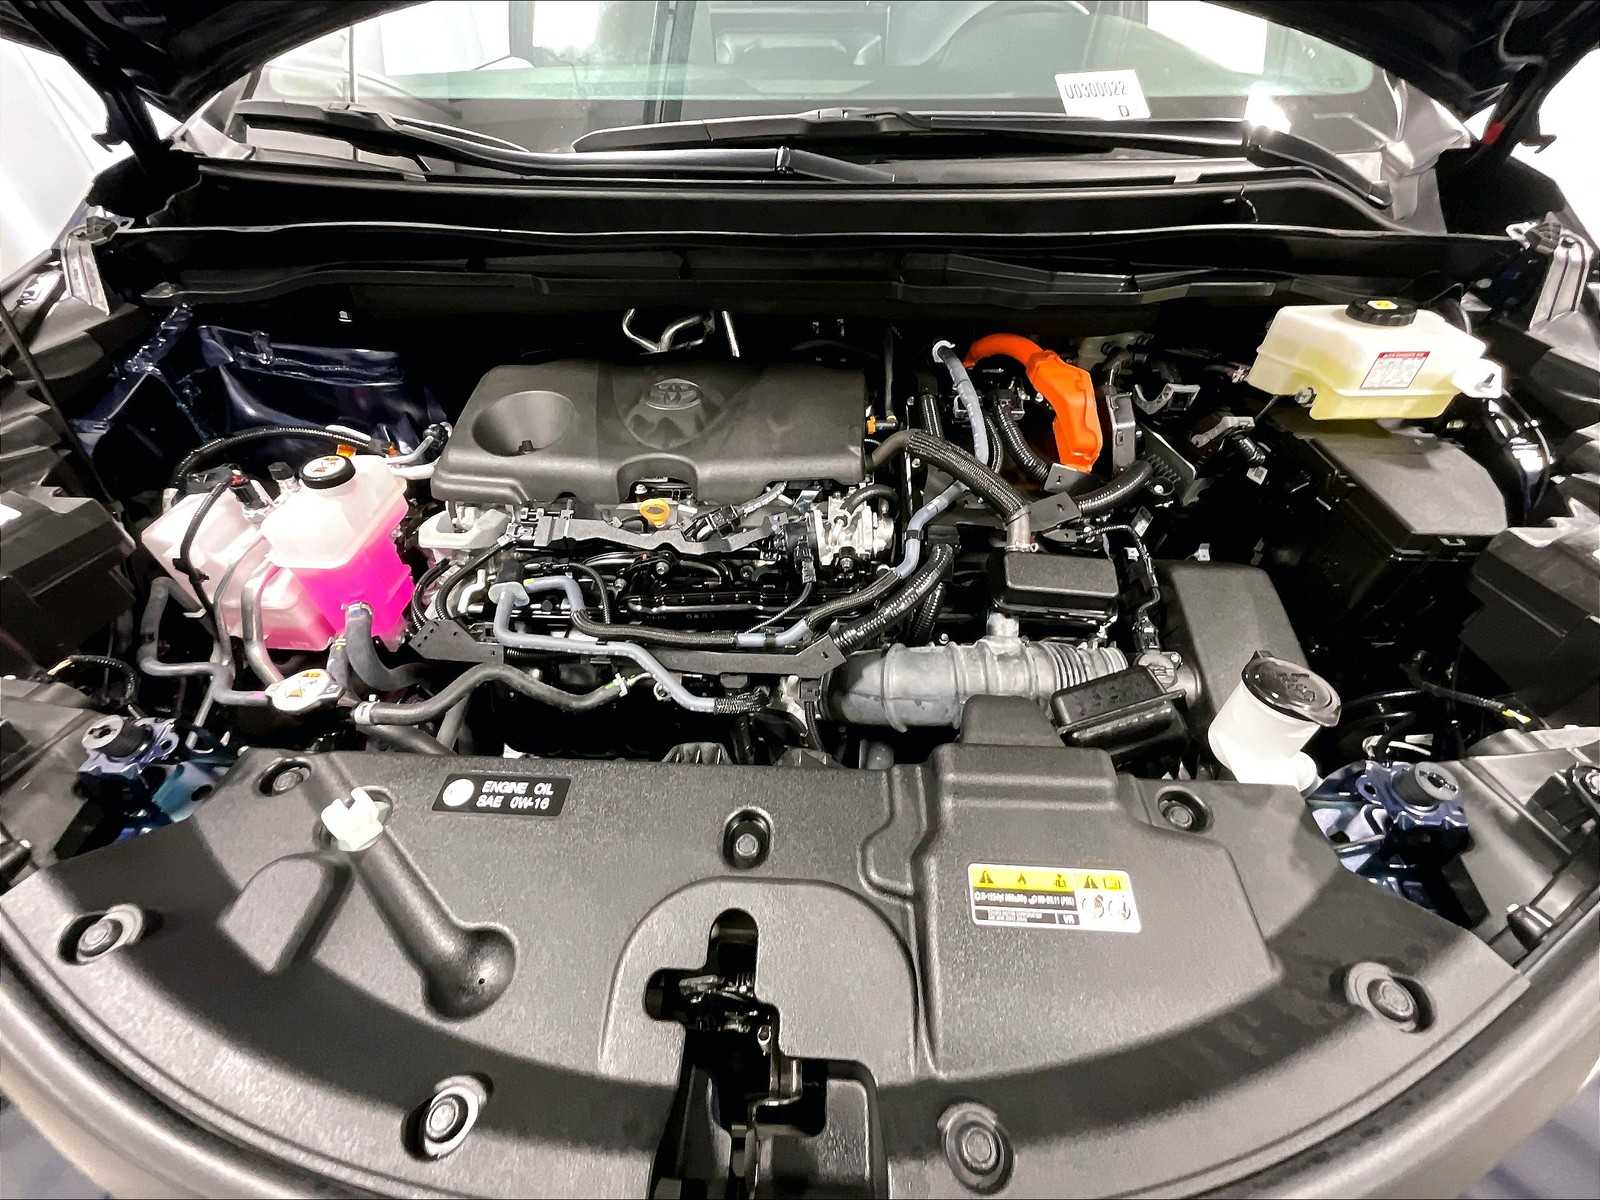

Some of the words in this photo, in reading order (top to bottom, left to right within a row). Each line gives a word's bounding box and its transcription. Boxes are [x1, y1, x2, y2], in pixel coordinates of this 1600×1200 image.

[481, 780, 529, 795] ENGINE
[533, 782, 555, 796] OIL
[476, 794, 505, 808] SAE
